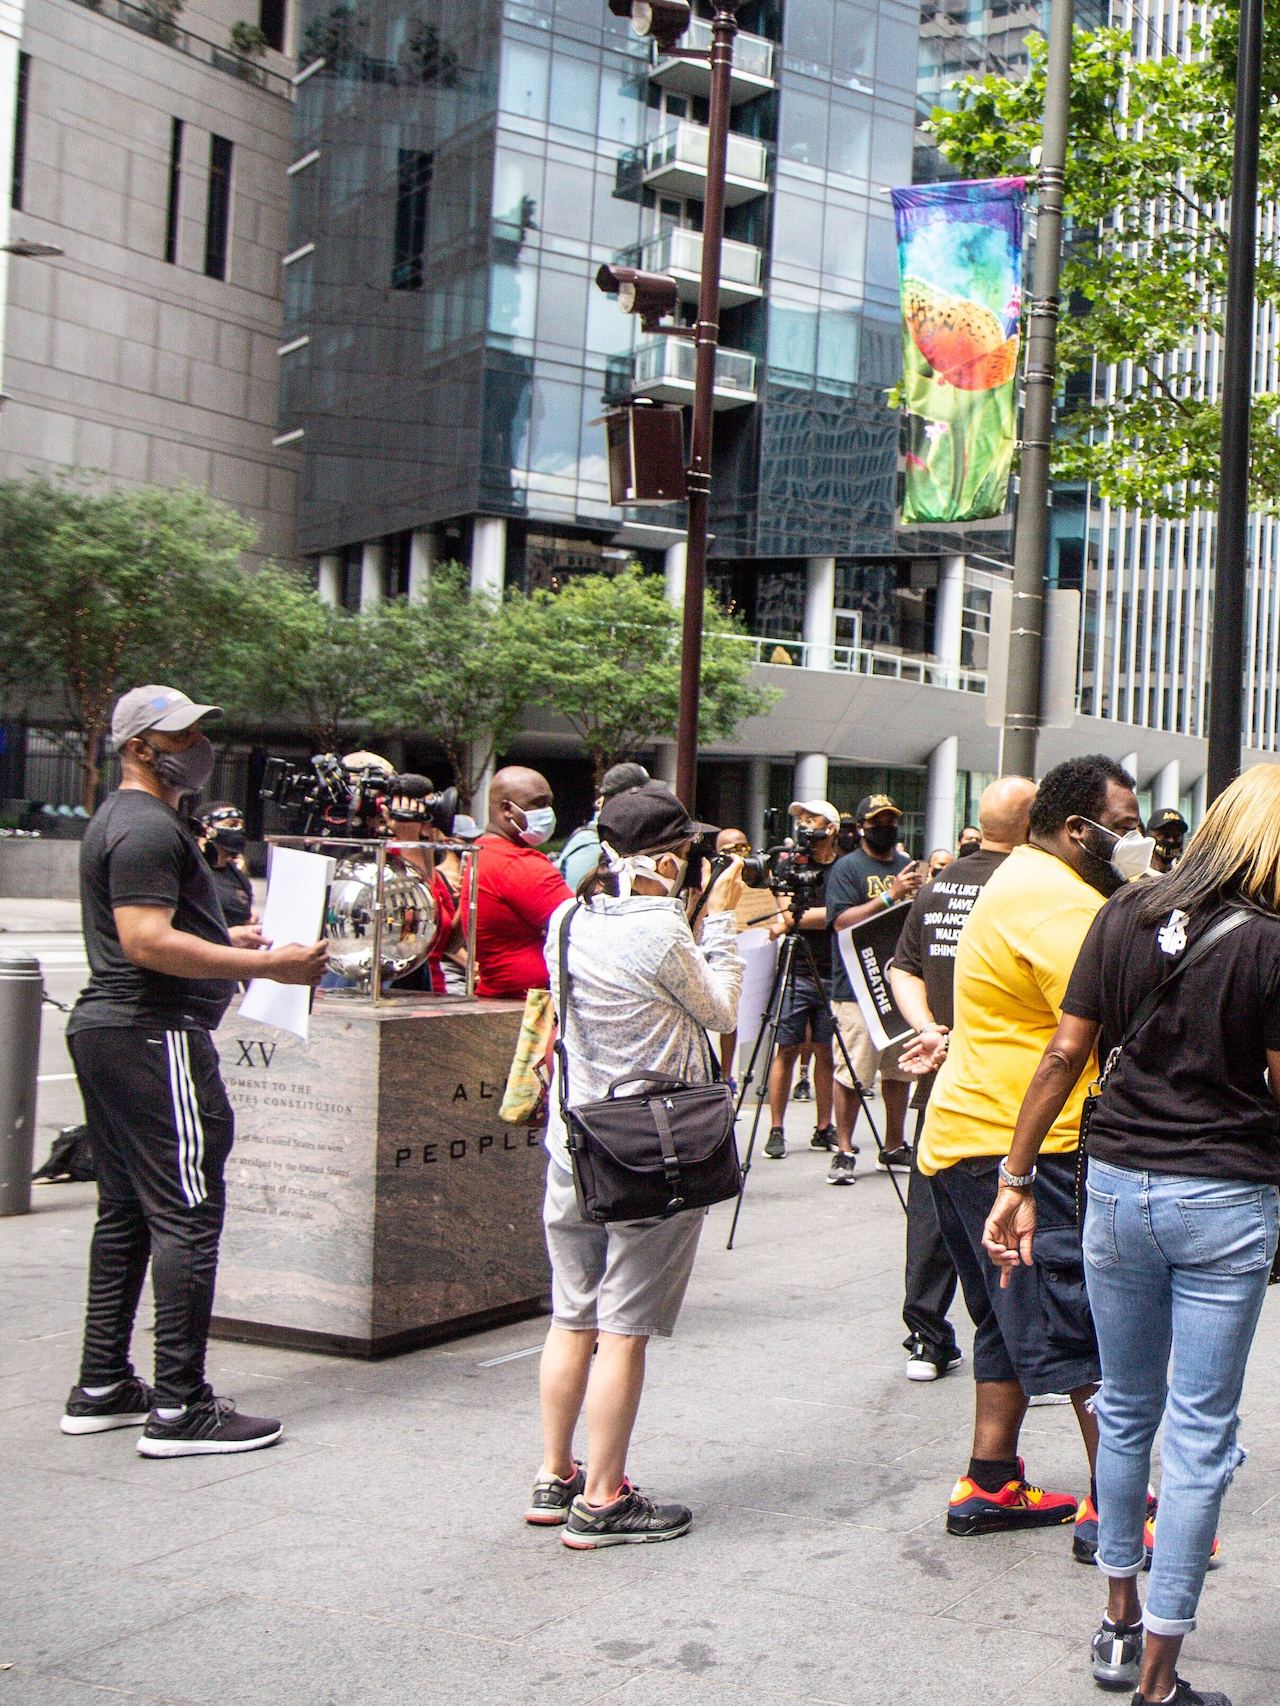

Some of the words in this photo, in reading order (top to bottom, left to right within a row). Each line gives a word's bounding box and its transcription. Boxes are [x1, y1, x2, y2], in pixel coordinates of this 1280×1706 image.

[932, 882, 958, 895] WALK
[957, 884, 979, 896] LIKE
[947, 898, 974, 911] HAVE
[942, 913, 969, 926] ANCE
[935, 928, 961, 941] WALK
[861, 946, 893, 1015] BREATHE
[236, 1040, 277, 1068] XV
[272, 1082, 286, 1091] TO
[291, 1084, 313, 1095] THE
[453, 1078, 508, 1102] AL
[263, 1097, 354, 1114] CONSTITUTION
[396, 1129, 539, 1167] PEOPLE
